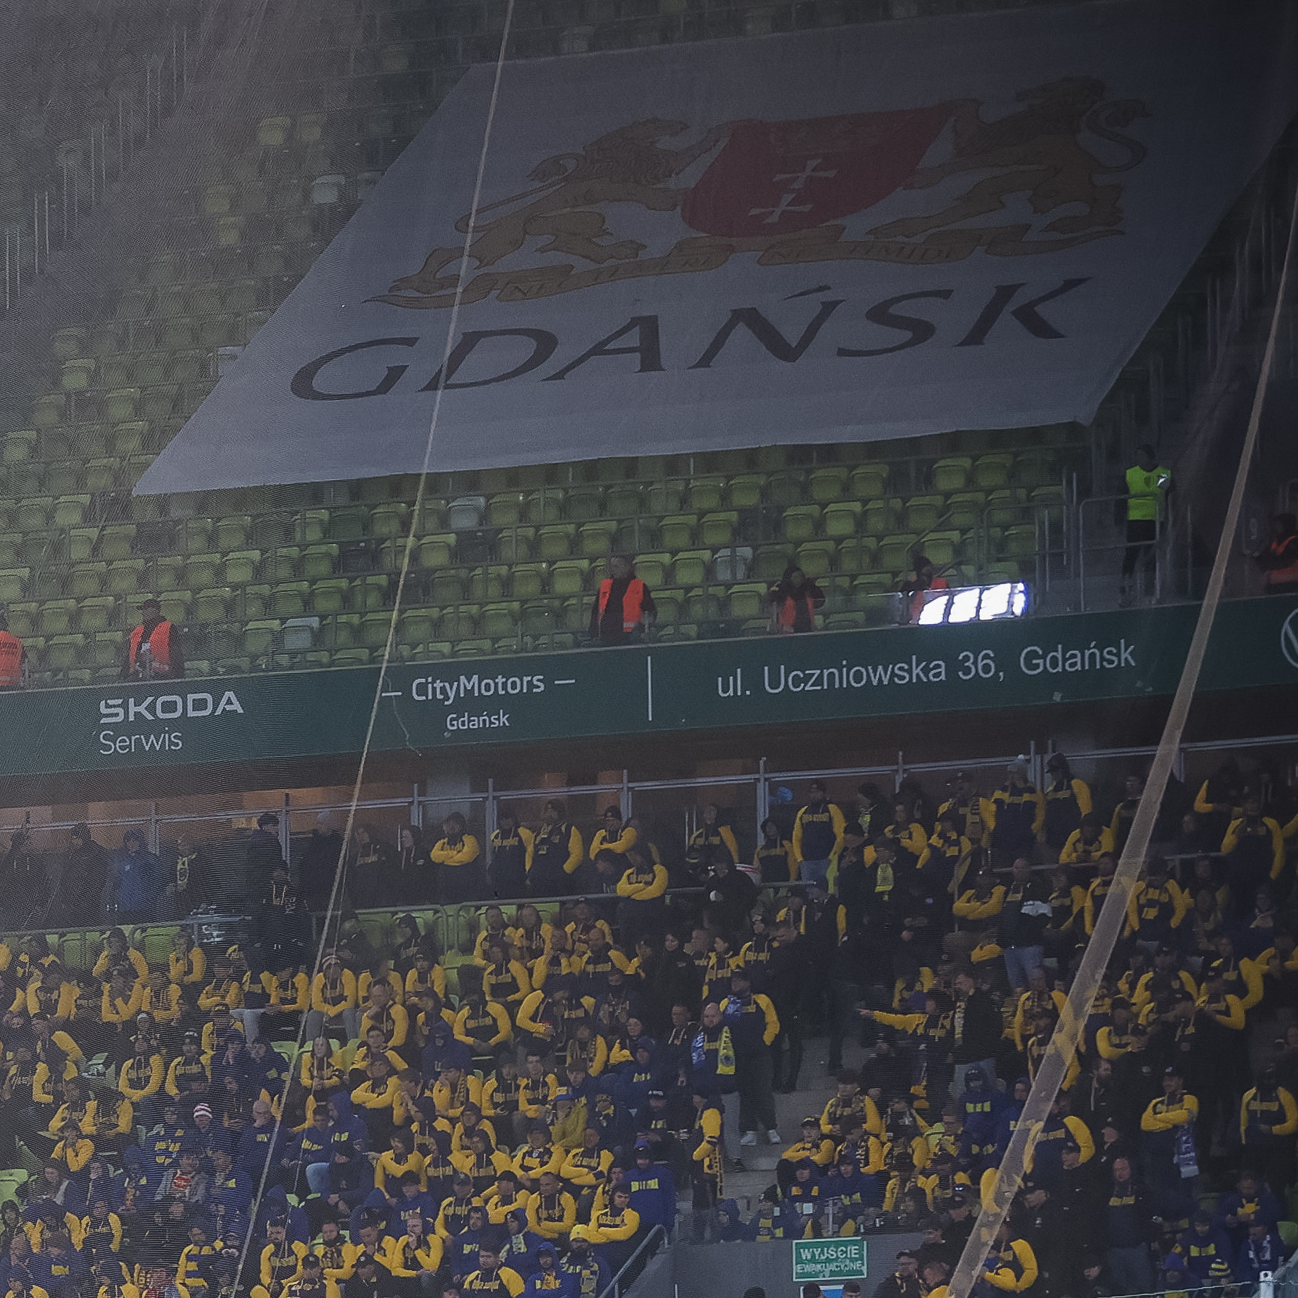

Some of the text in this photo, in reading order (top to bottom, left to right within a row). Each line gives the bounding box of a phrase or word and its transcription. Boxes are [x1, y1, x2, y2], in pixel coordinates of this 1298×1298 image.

[290, 277, 1094, 402] GDAŃSK
[717, 638, 1137, 697] ul. Uczniowska 36, Gdańsk
[412, 675, 545, 706] CityMotors
[446, 709, 510, 731] Gdańsk
[100, 727, 182, 755] Serwis
[800, 1245, 859, 1260] WYJŚCIE
